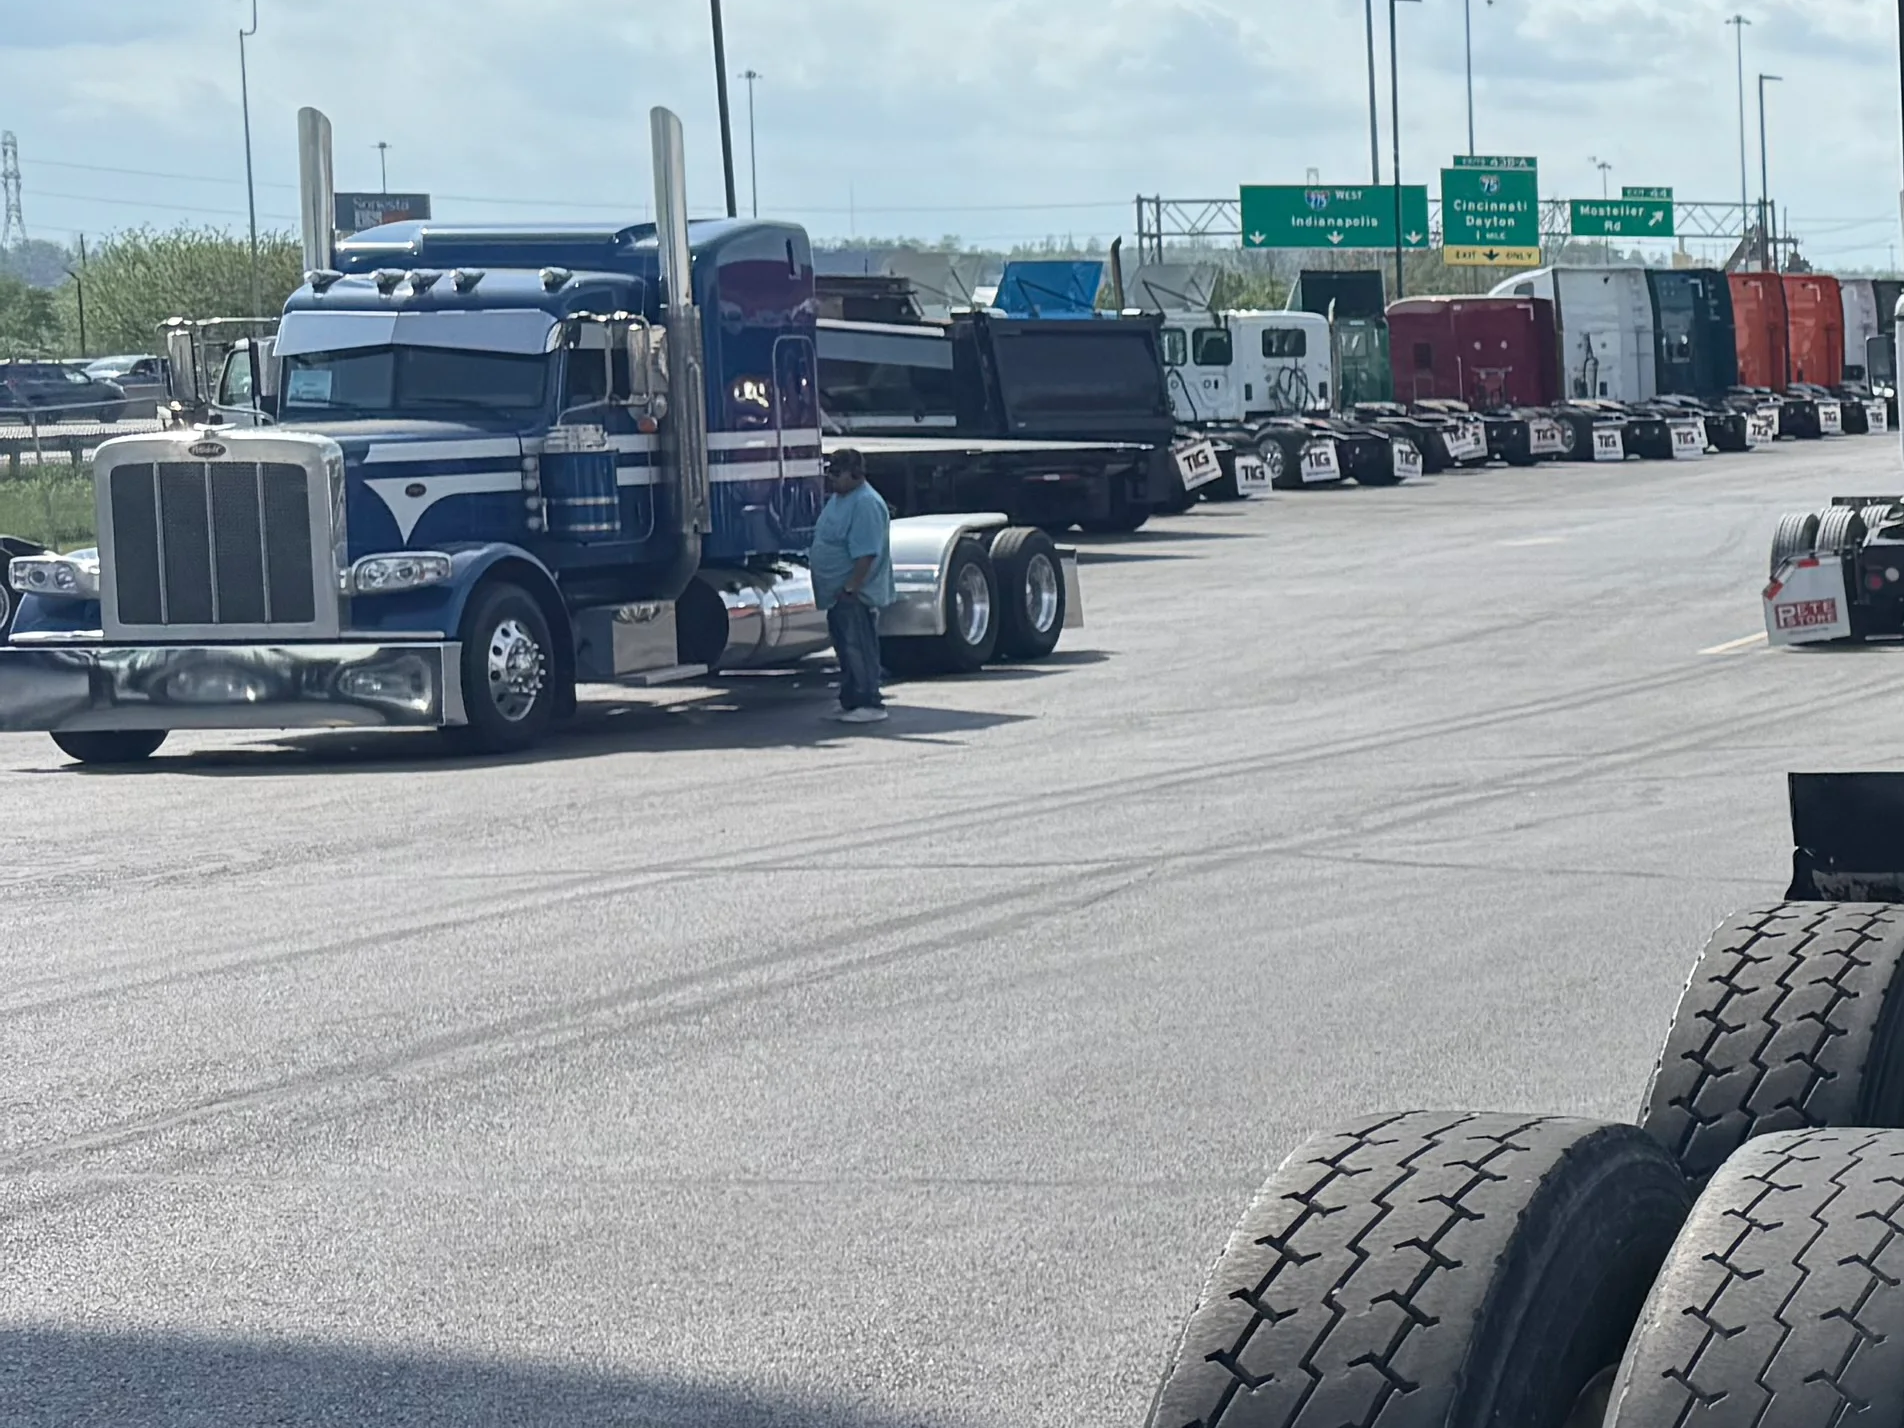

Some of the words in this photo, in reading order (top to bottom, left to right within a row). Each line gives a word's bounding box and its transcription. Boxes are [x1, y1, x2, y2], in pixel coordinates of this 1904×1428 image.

[1335, 190, 1362, 200] WEST
[1453, 199, 1527, 212] Cincinnati
[1580, 204, 1644, 217] Mosteller
[1291, 215, 1378, 228] Indianapolis
[1466, 215, 1515, 229] Dayton
[1604, 220, 1621, 232] Rd
[1456, 250, 1476, 260] EXIT
[1506, 252, 1532, 261] ONLY
[1787, 614, 1833, 626] STORE
